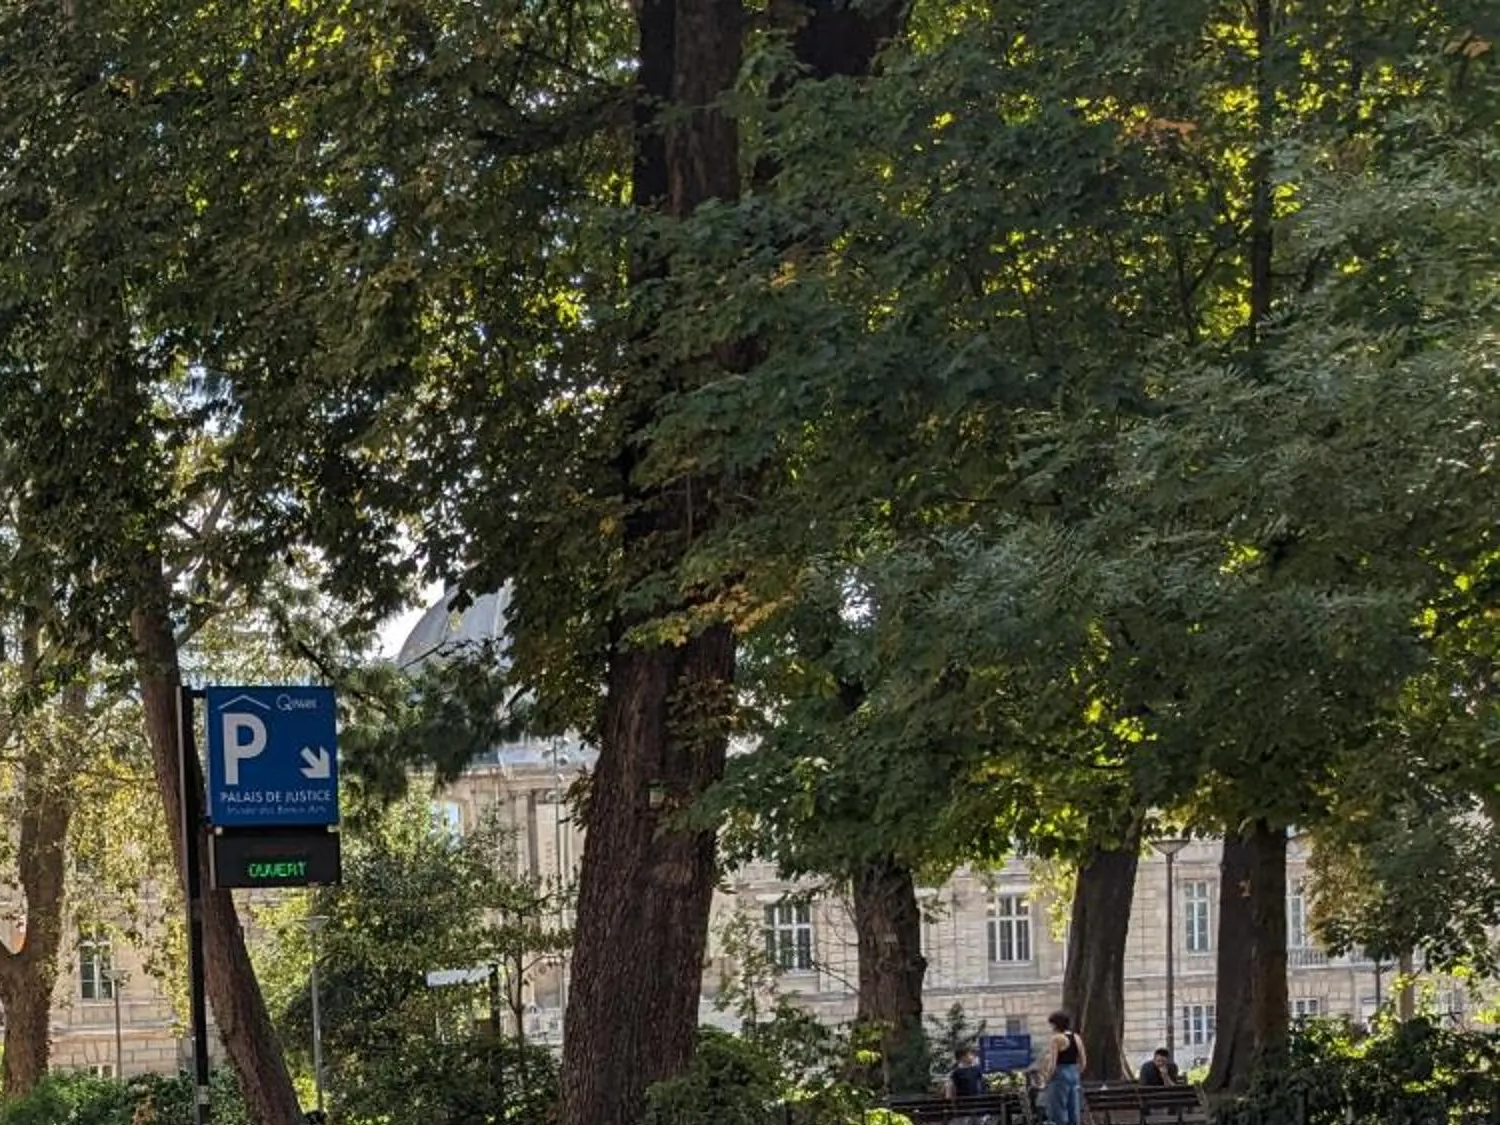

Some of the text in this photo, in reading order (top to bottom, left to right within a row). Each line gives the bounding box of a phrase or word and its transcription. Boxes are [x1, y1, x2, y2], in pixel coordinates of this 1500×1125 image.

[222, 712, 267, 785] P
[220, 788, 332, 803] PALAIS DE JUSTICE
[248, 861, 306, 877] OUVERT
